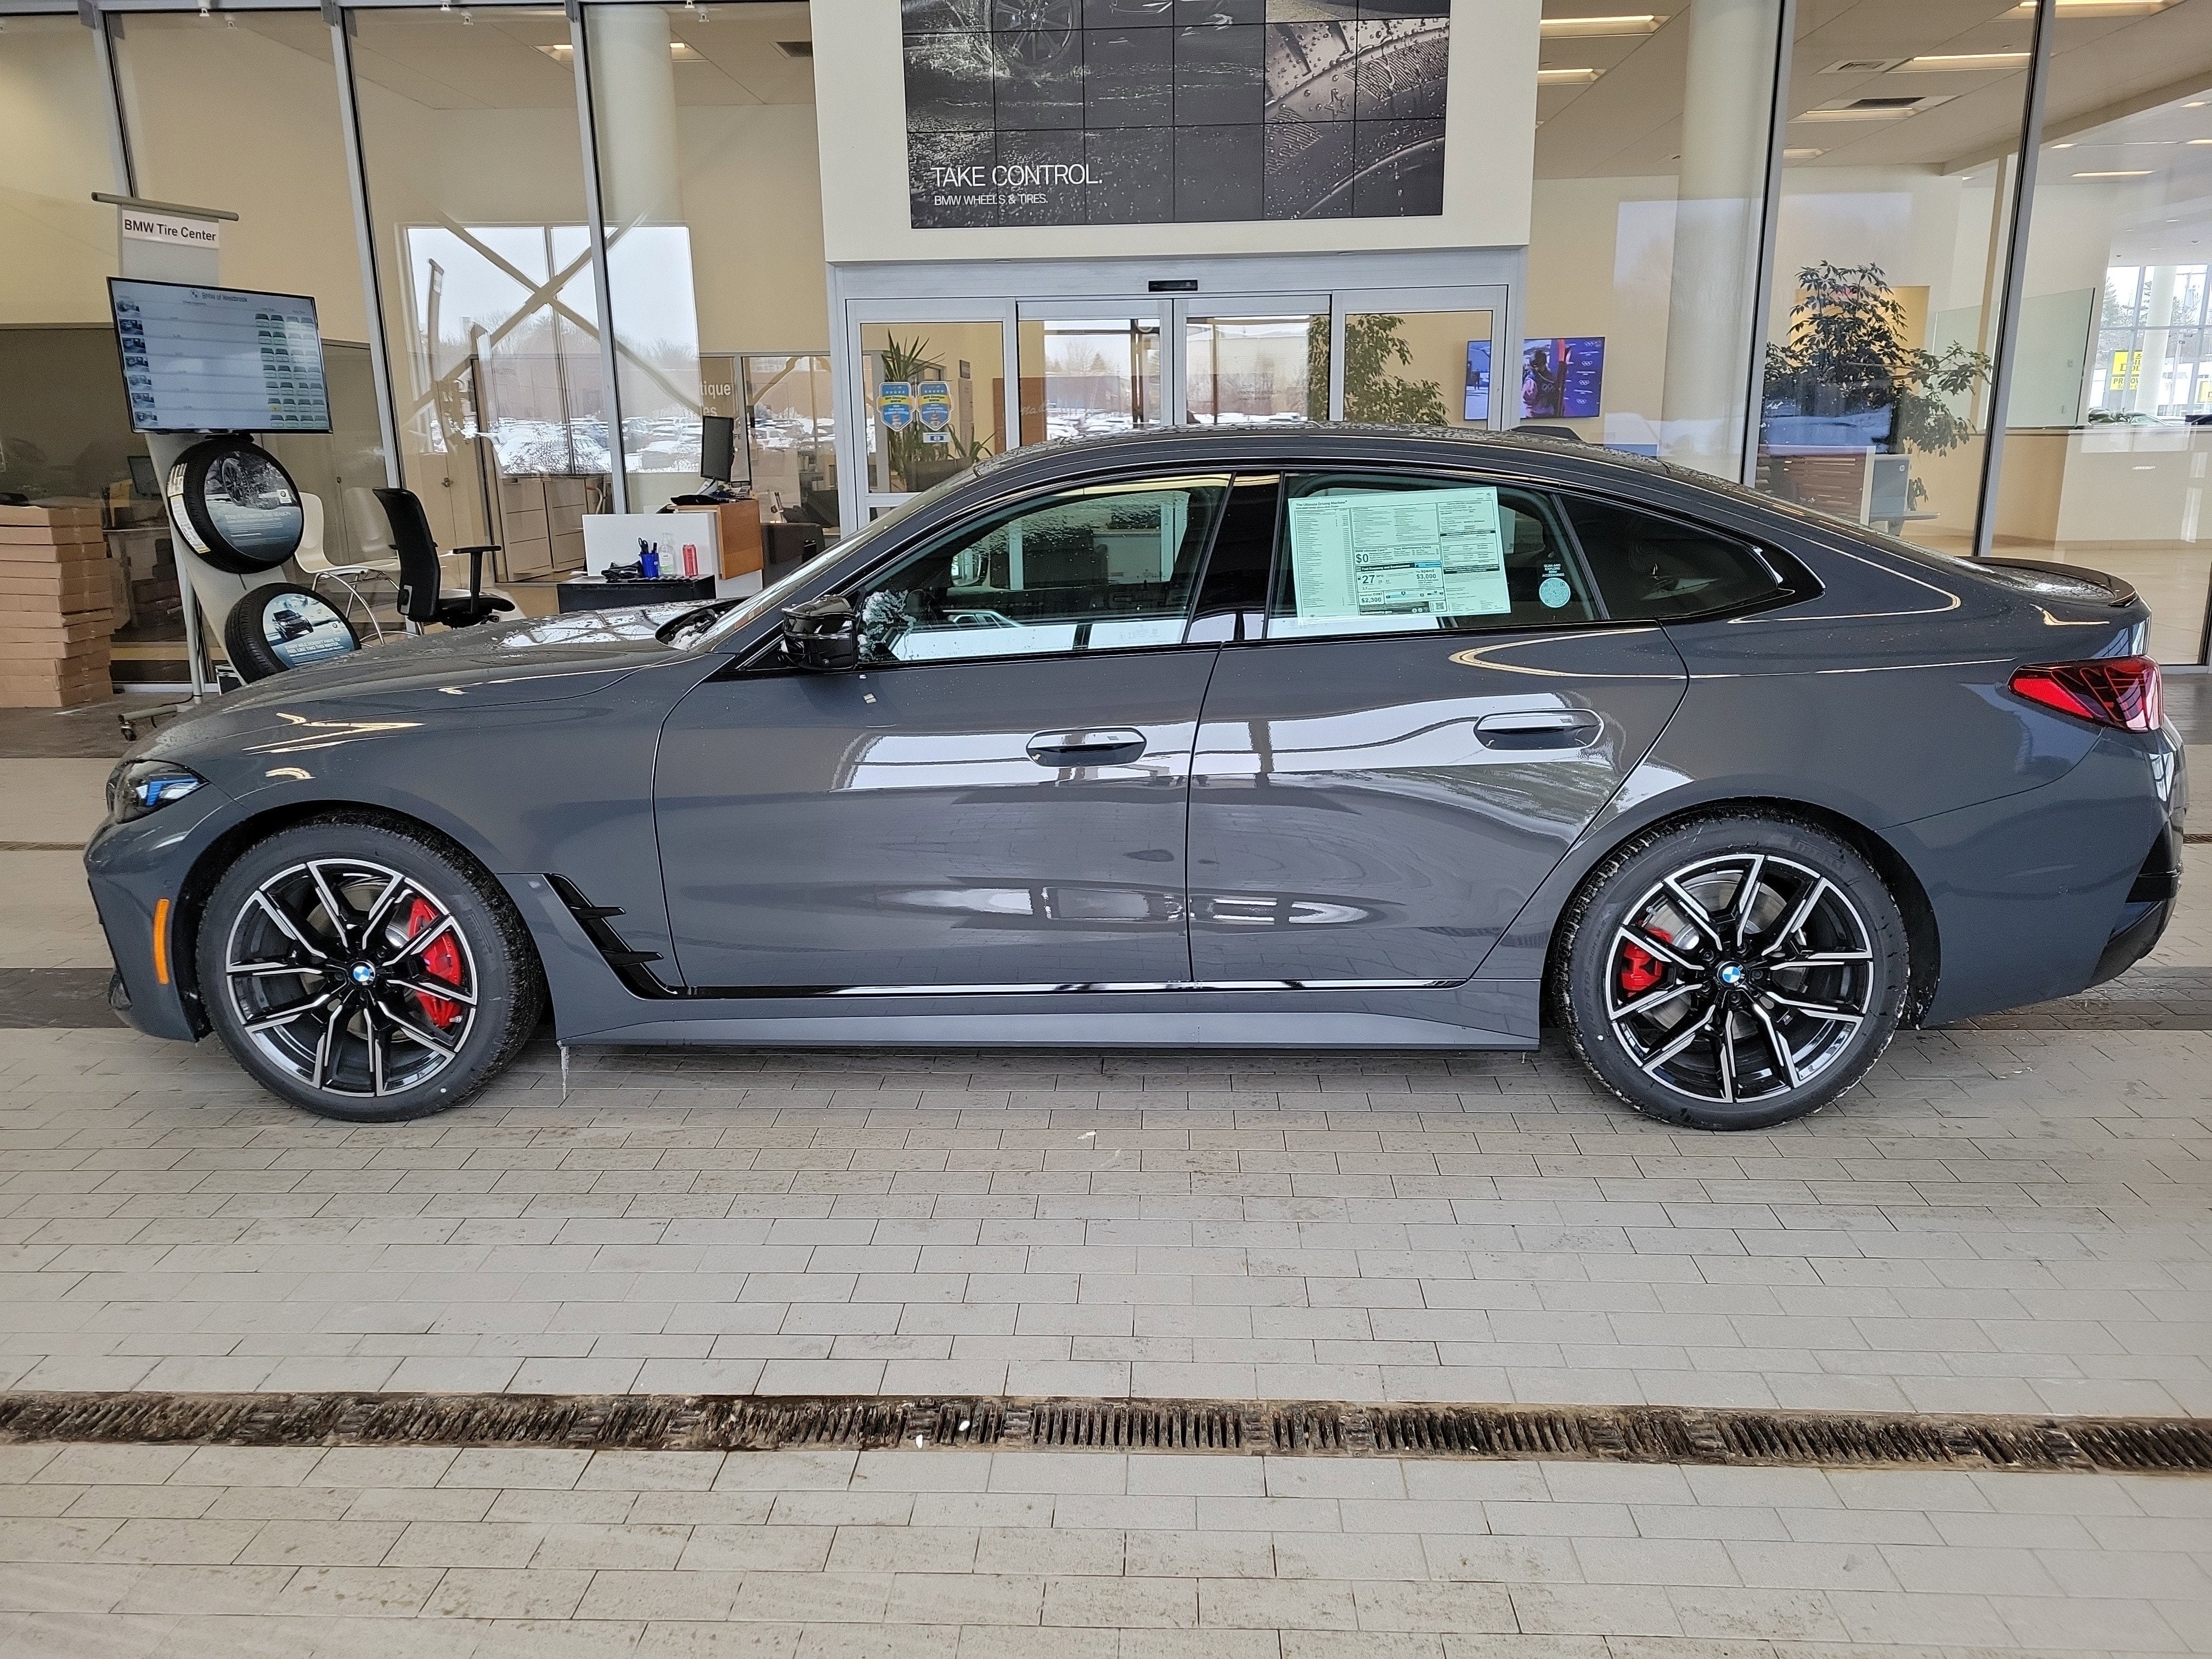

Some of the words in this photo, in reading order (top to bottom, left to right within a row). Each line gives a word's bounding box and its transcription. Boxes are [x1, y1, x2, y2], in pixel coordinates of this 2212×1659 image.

[930, 166, 986, 187] TAKE
[992, 163, 1103, 187] CONTROL.
[934, 195, 962, 206] BMW
[963, 194, 1006, 205] WHEELS
[1008, 194, 1017, 205] &
[1018, 193, 1048, 205] TIRES.
[124, 219, 154, 233] BMW
[156, 223, 178, 236] Tire
[180, 227, 216, 241] Center
[1356, 554, 1368, 564] $0
[1362, 574, 1375, 584] 27
